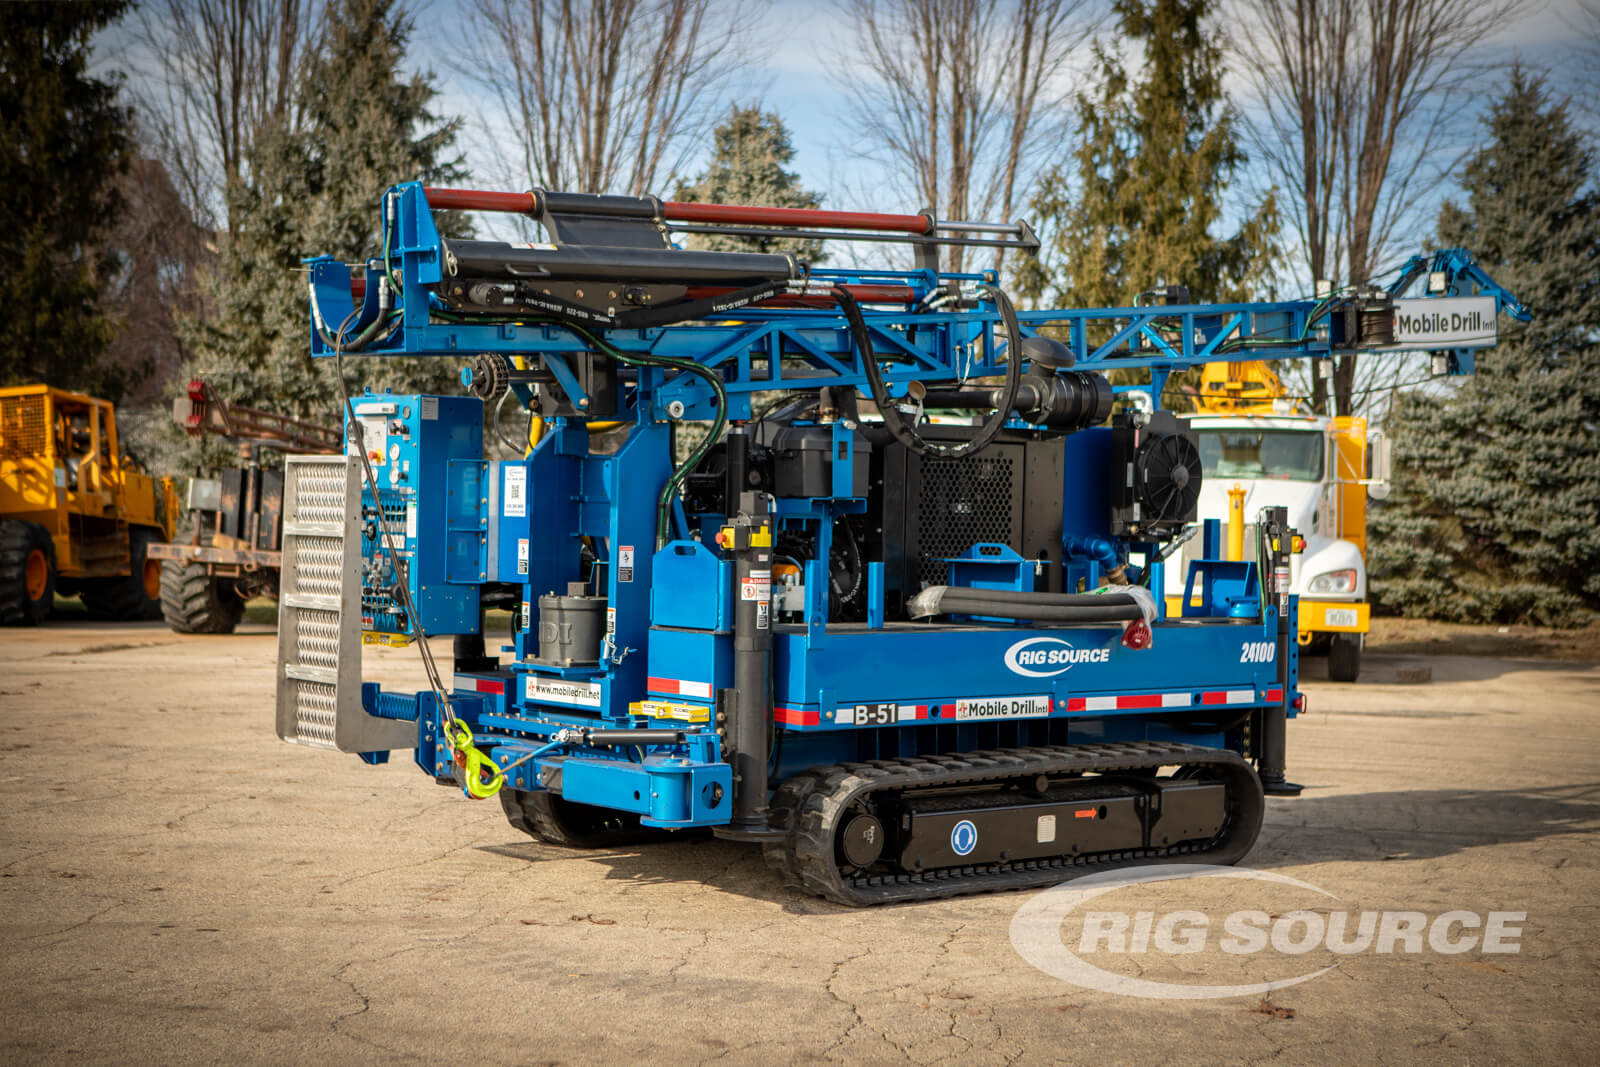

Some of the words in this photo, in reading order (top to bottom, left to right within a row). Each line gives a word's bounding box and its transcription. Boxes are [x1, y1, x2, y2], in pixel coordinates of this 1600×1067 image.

[1399, 313, 1449, 334] Mobile
[1451, 311, 1480, 332] Drill
[1018, 650, 1045, 665] RIG
[1048, 648, 1110, 664] SOURCE
[1240, 642, 1276, 663] 24100
[535, 684, 600, 700] www.mobiledrill.net
[854, 703, 897, 725] B-51
[968, 701, 1007, 717] Mobile
[1011, 700, 1035, 715] Drill
